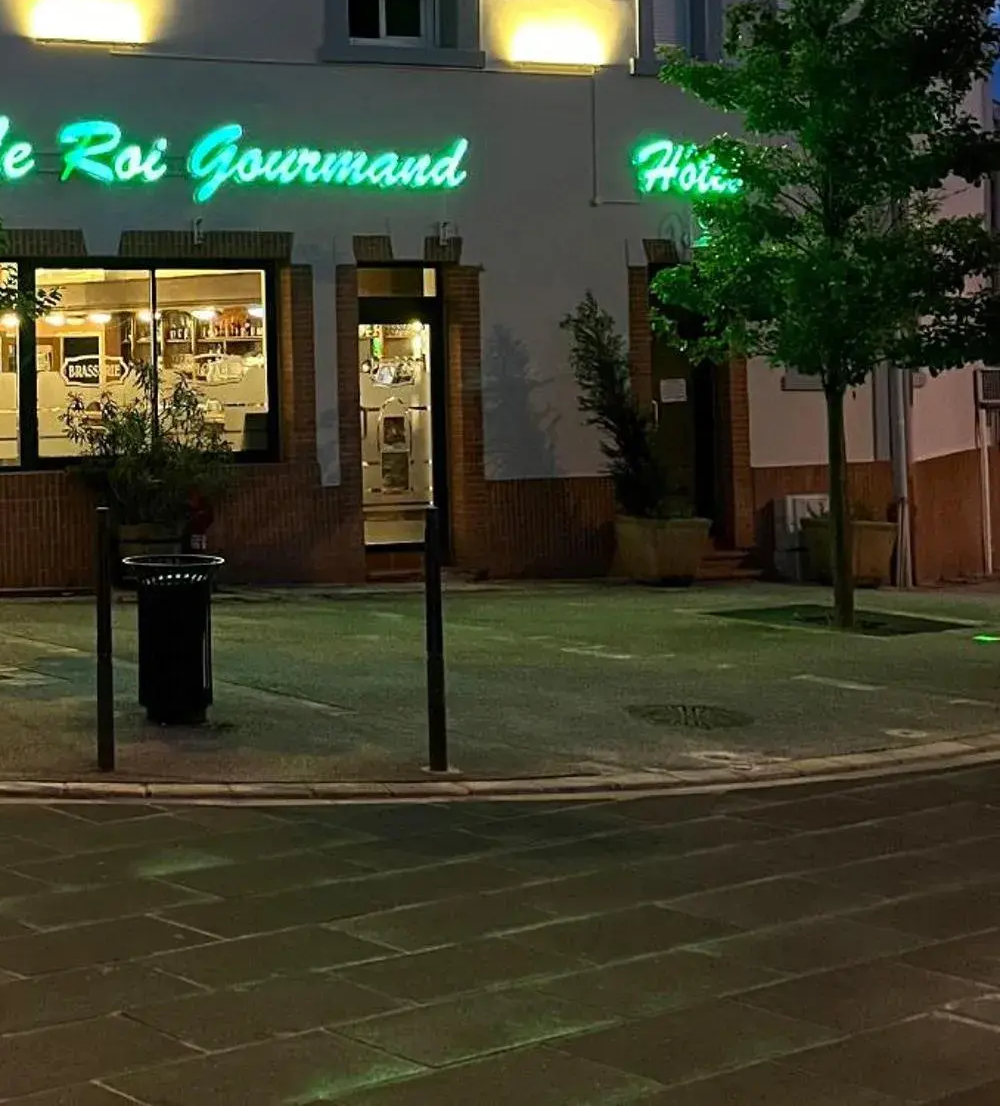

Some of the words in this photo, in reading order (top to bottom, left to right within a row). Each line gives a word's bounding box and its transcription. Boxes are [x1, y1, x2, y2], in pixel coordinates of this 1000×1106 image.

[58, 120, 168, 182] Roi
[188, 124, 467, 202] Gourmand
[68, 363, 121, 379] BRASSRIE
